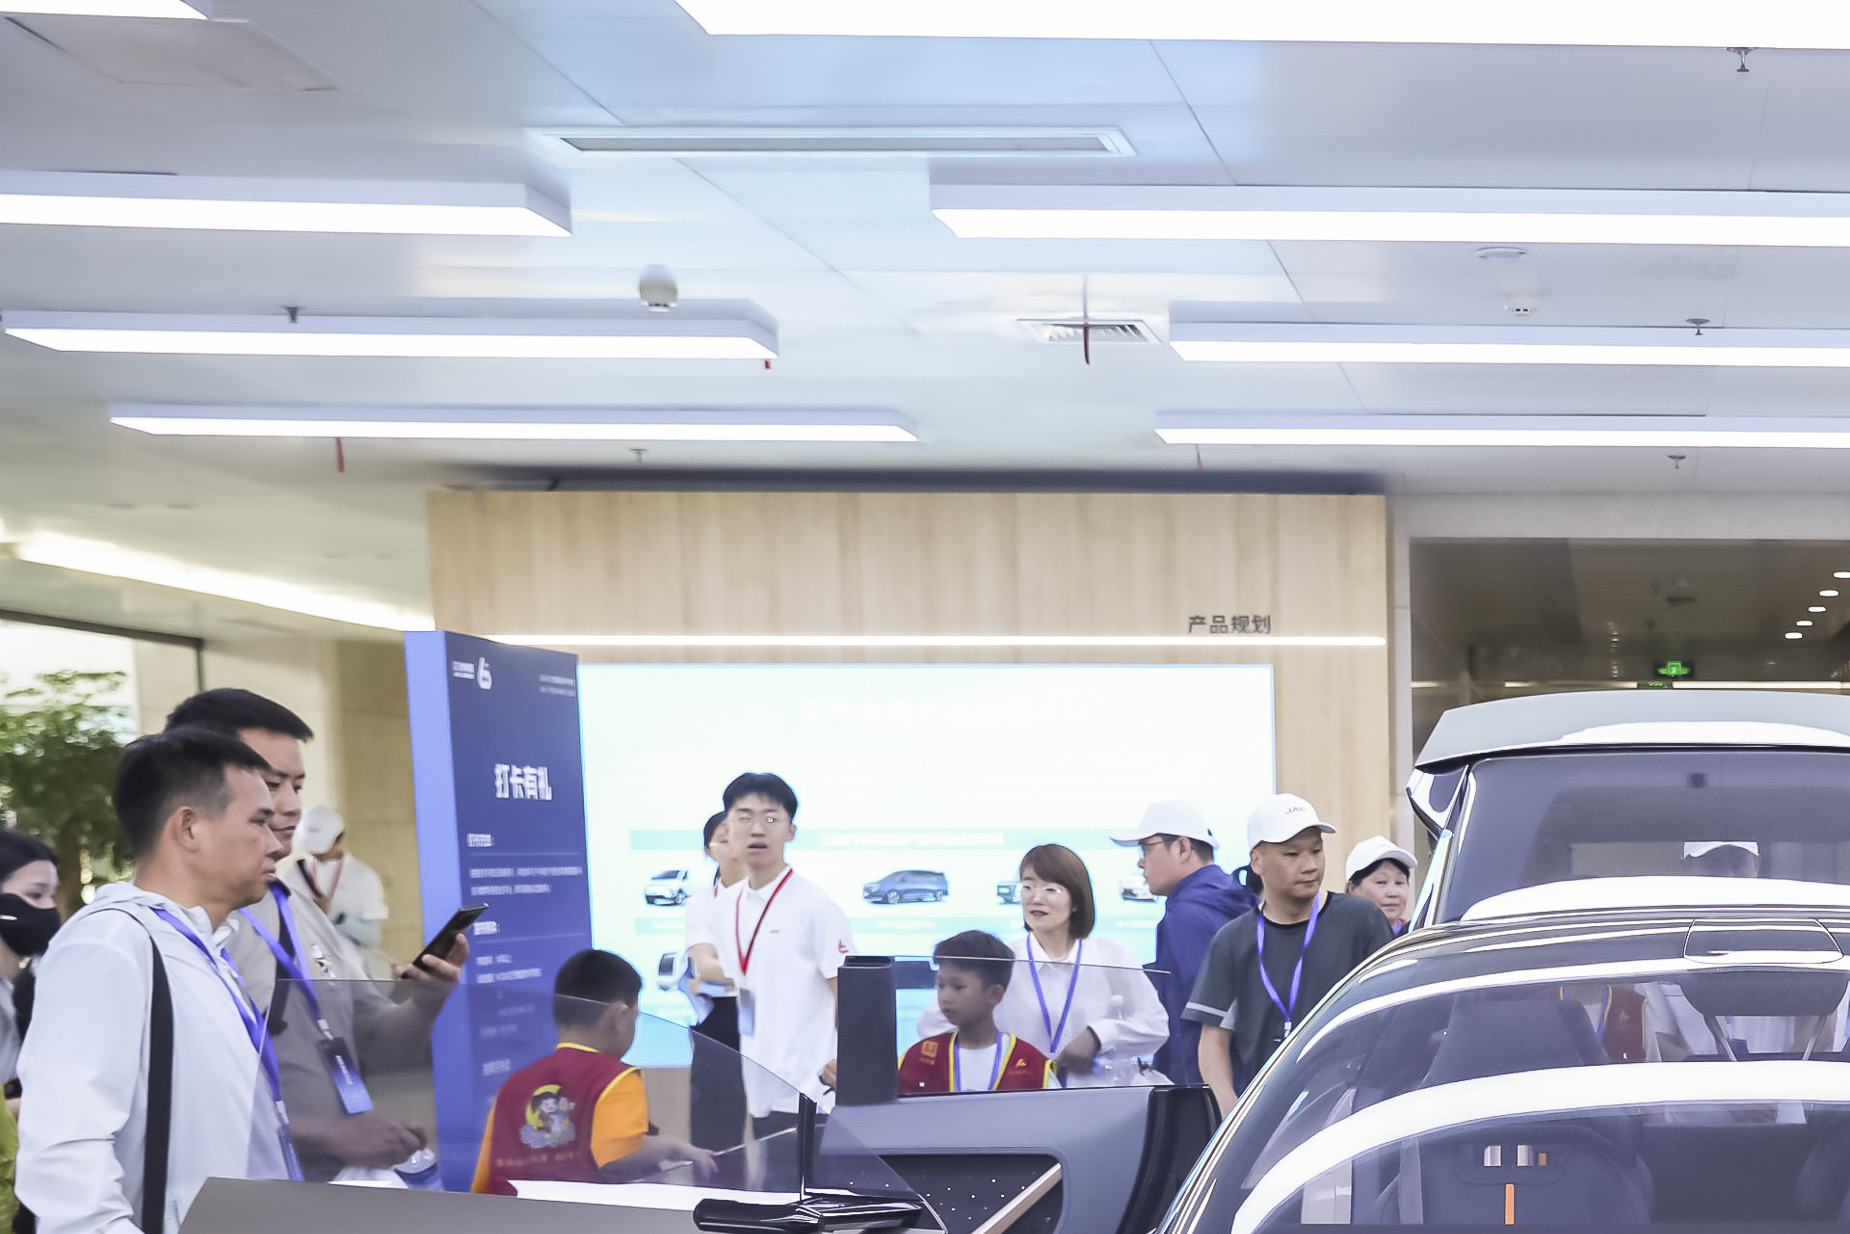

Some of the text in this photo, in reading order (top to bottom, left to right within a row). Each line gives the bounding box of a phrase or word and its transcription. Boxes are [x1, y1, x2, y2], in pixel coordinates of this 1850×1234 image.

[1188, 615, 1272, 634] 产品规划
[494, 763, 552, 801] 打卡有礼
